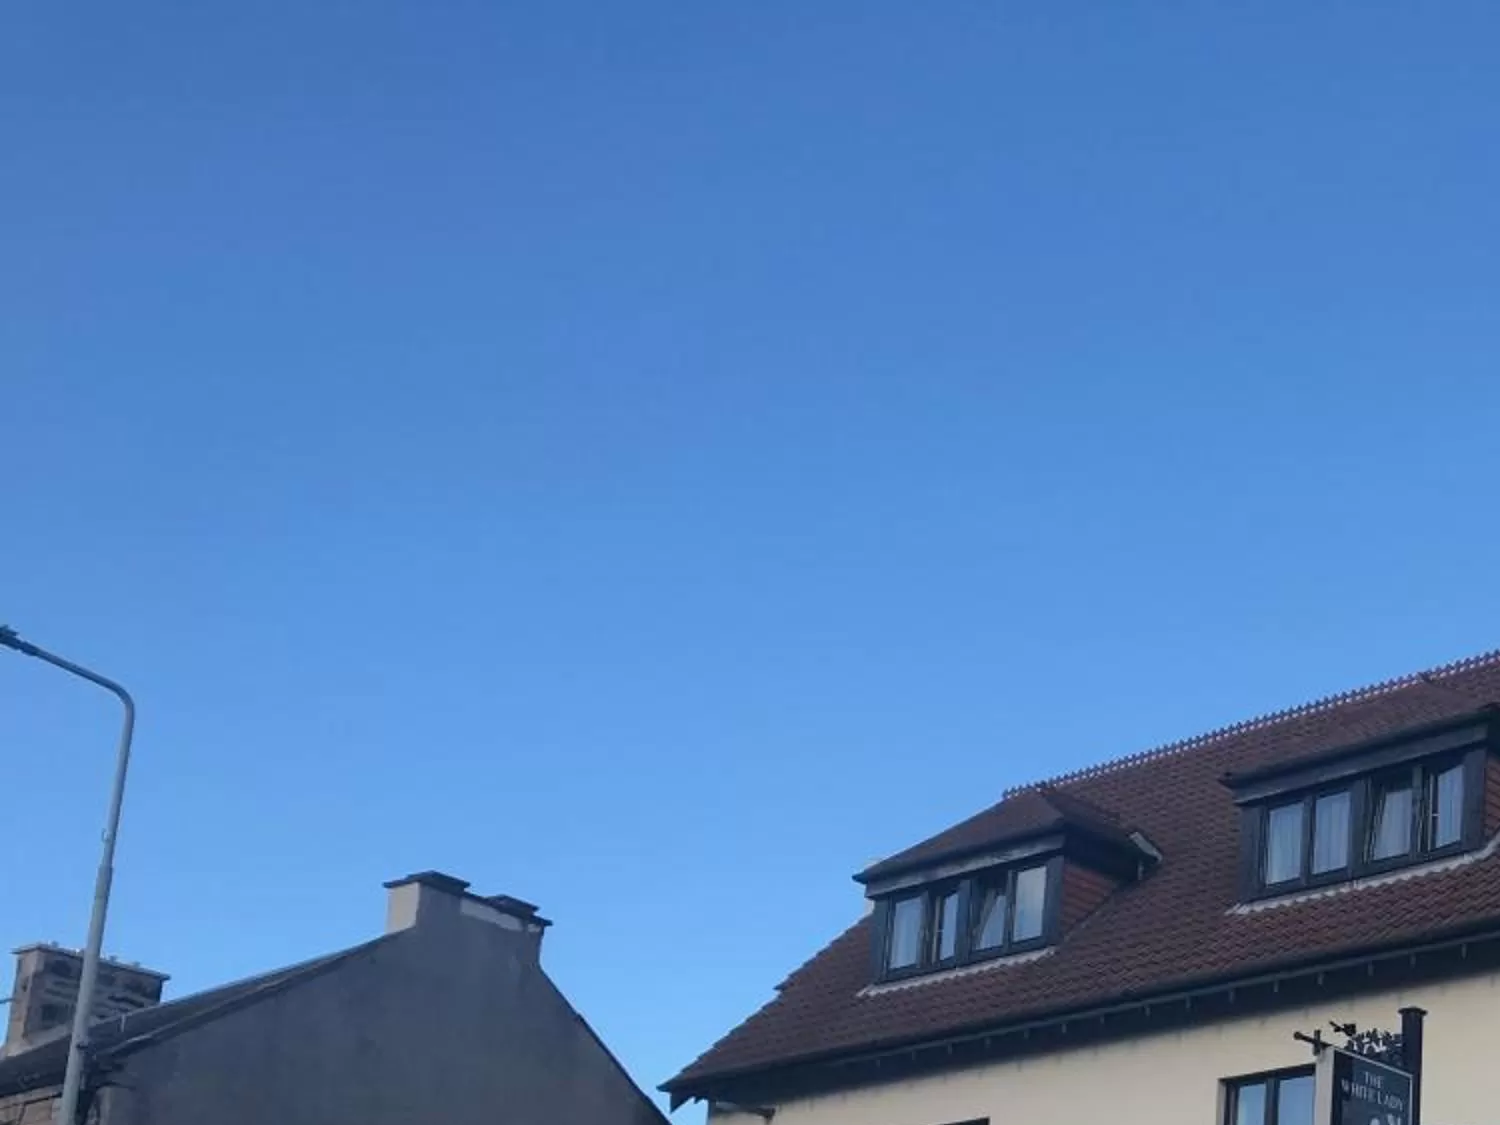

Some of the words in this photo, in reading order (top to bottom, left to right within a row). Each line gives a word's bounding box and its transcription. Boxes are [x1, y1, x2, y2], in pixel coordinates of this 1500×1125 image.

[1363, 1071, 1385, 1089] THE
[1341, 1077, 1377, 1103] WHITE
[1377, 1090, 1404, 1113] LADY
